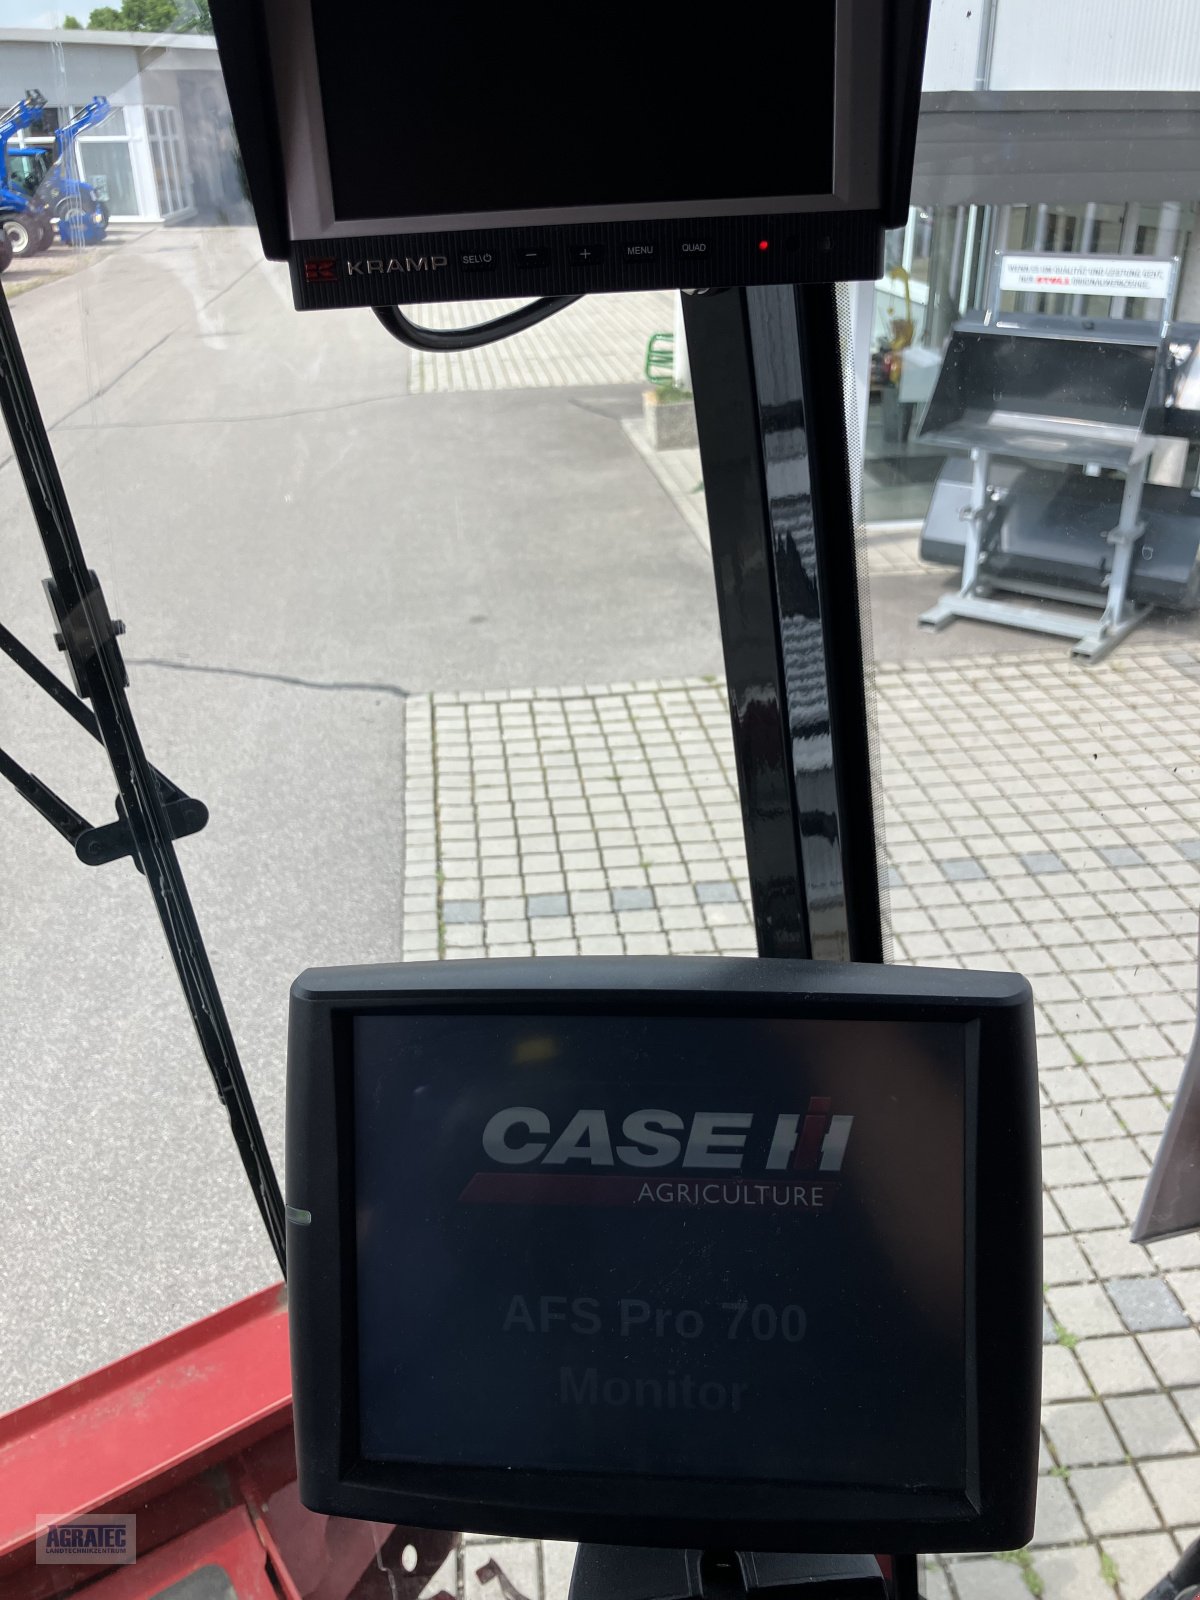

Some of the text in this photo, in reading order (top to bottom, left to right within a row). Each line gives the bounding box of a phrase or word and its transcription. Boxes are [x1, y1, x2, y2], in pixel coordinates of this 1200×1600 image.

[626, 245, 654, 256] MENU
[681, 243, 707, 252] QUAD
[347, 256, 448, 275] KRAMP
[482, 1106, 754, 1168] CASE
[637, 1182, 824, 1207] AGRICULTURE
[502, 1294, 808, 1343] AFS Pro 700
[558, 1365, 748, 1413] Monitor
